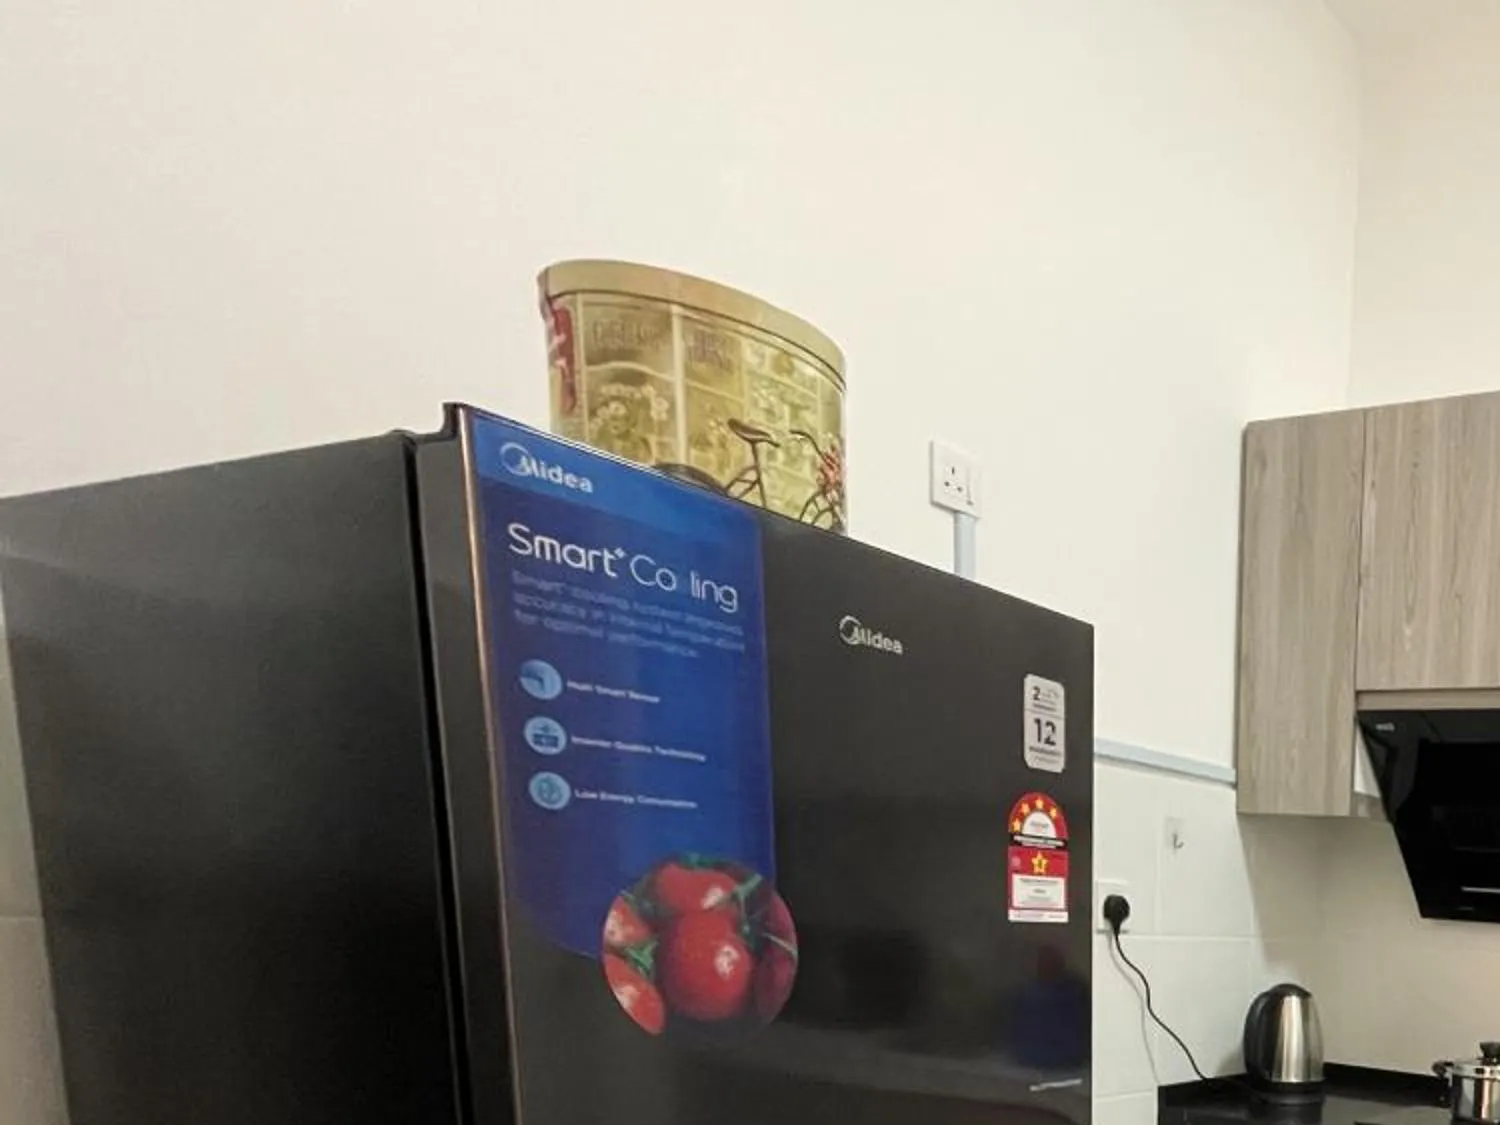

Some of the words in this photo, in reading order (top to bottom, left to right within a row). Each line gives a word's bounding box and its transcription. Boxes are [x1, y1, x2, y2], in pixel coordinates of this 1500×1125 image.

[500, 442, 594, 494] Midea
[839, 614, 904, 655] Midea
[1033, 717, 1057, 746] 12
